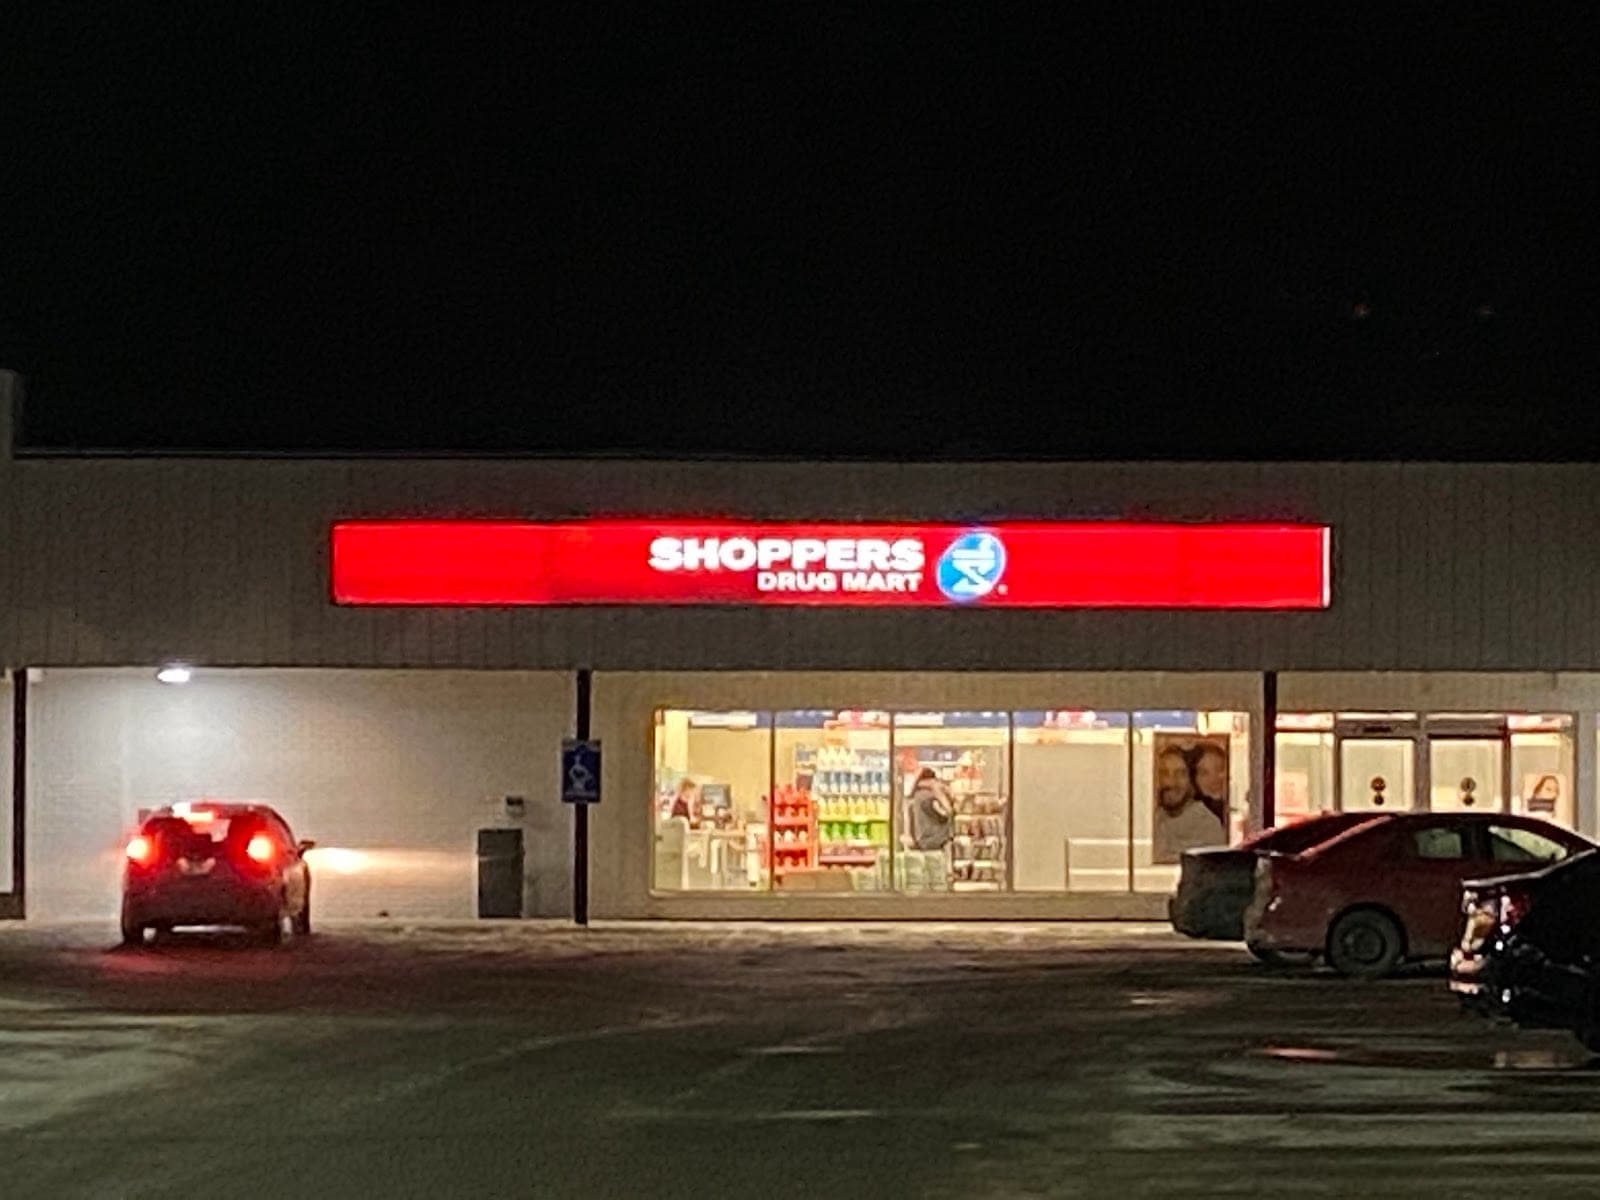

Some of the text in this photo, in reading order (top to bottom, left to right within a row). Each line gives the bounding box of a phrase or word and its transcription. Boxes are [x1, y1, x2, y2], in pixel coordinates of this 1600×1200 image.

[648, 537, 924, 570] SHOPPERS
[757, 572, 922, 591] DRUG MART
